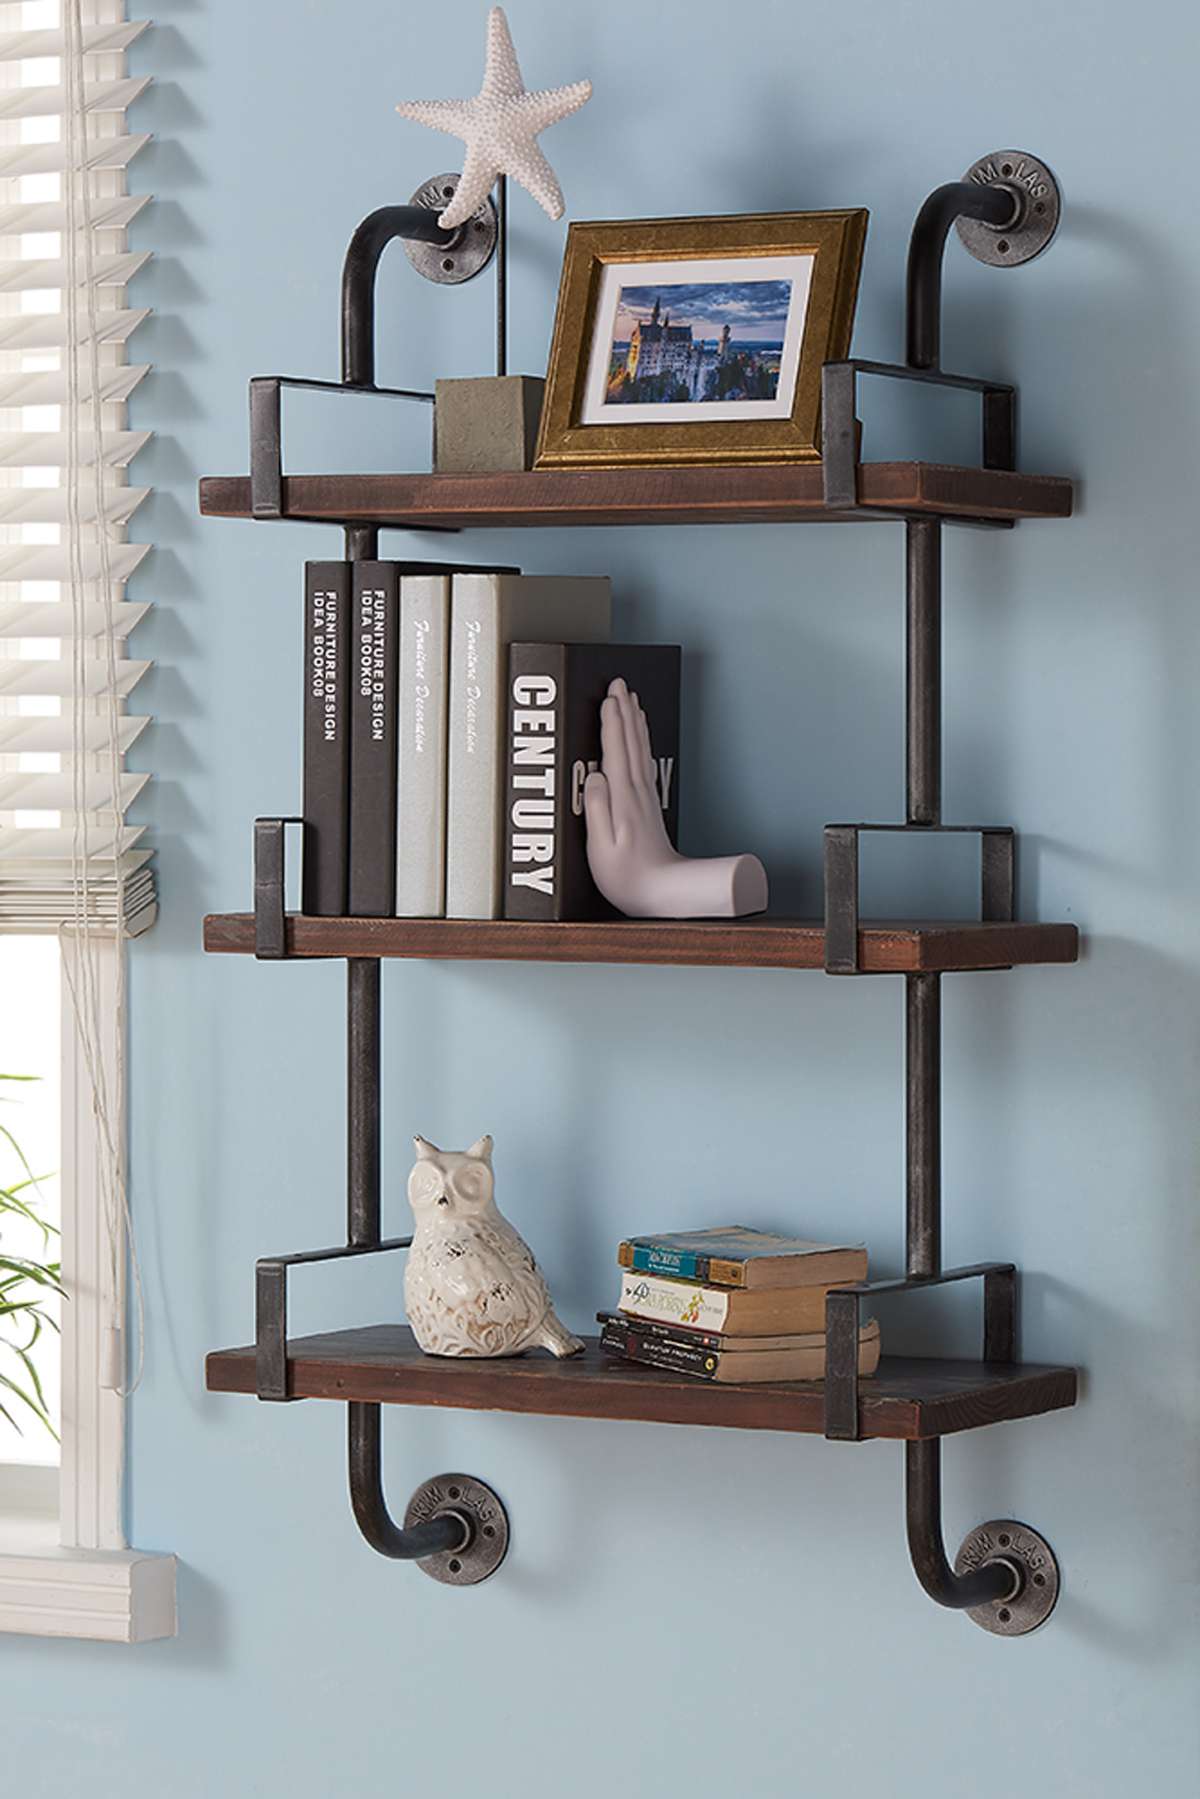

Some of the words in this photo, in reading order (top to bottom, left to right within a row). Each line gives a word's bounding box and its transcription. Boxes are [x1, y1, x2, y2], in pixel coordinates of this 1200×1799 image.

[1015, 161, 1048, 199] LAS
[313, 591, 324, 628] IDEA
[325, 591, 337, 680] FURNITURE
[361, 589, 372, 627] IDEA
[373, 589, 385, 679] FURNITURE
[313, 635, 324, 697] BOOK08
[361, 634, 371, 696] BOOK08
[324, 683, 336, 741] DESIGN
[372, 682, 384, 740] DESIGN
[510, 673, 558, 897] CENTURY
